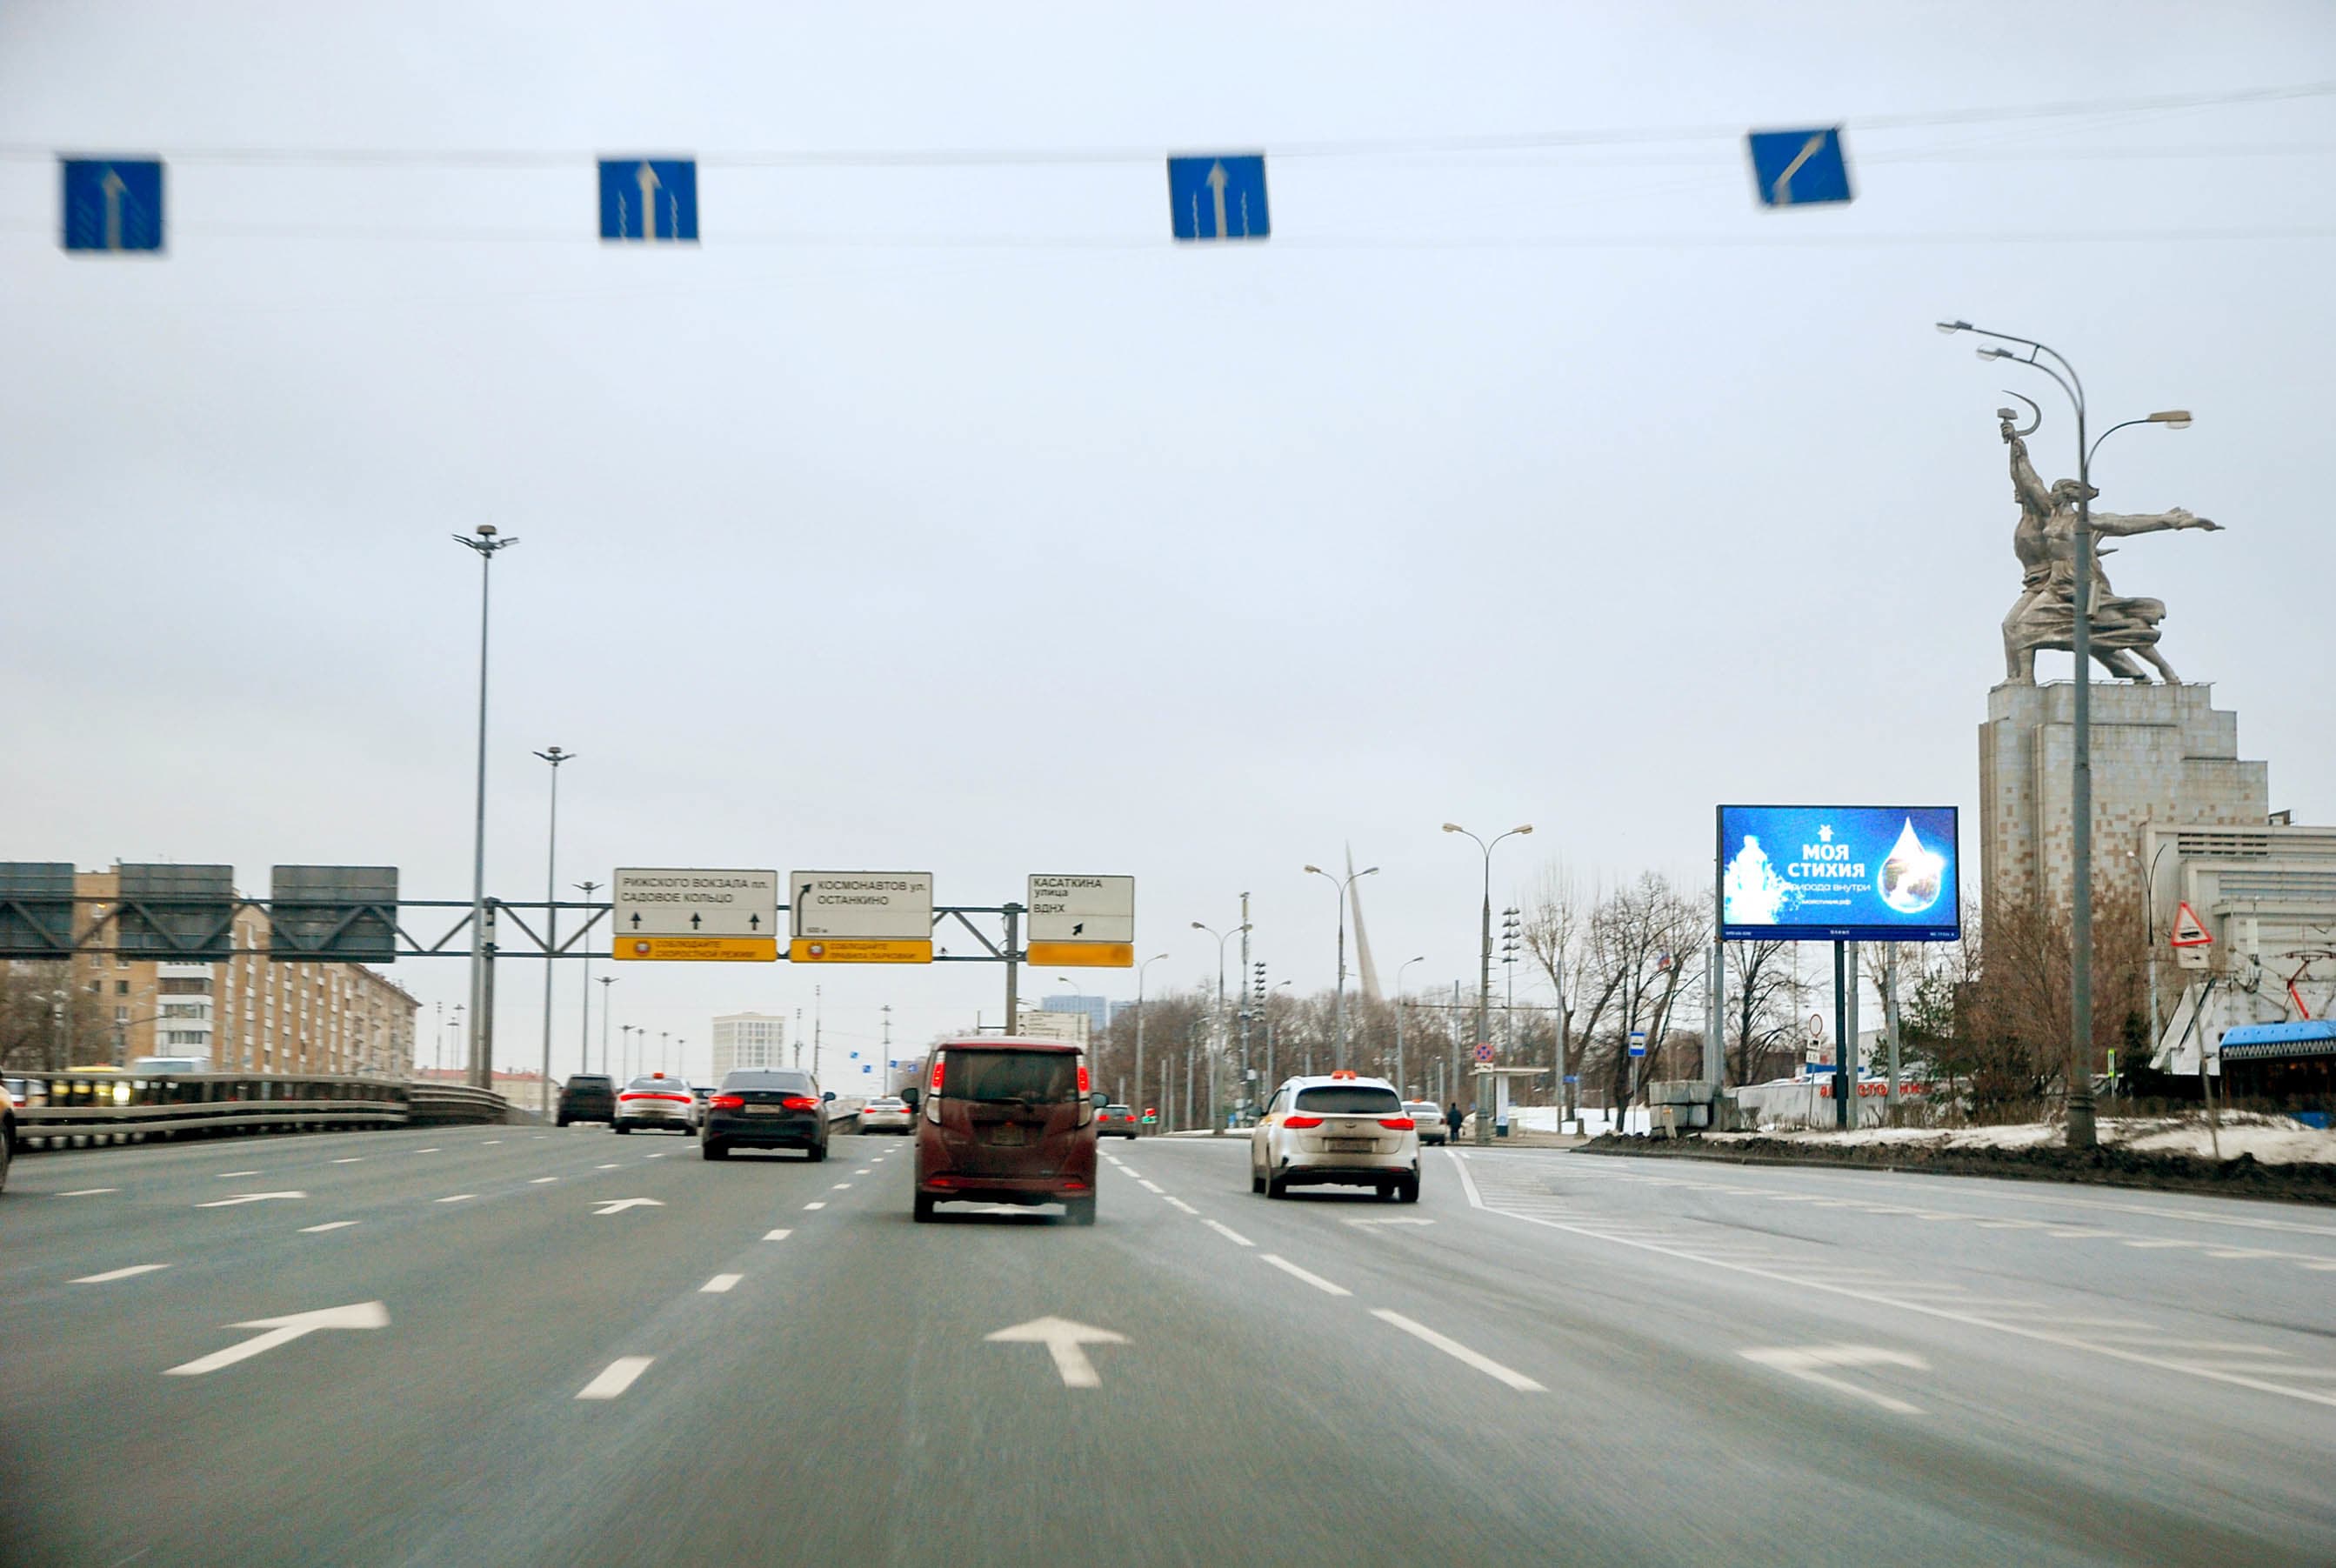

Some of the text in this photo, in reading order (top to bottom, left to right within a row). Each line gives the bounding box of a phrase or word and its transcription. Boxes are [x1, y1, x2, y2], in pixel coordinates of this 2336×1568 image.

[1803, 844, 1849, 861] МОЯ
[1787, 863, 1865, 878] СТИХИЯ
[623, 877, 690, 888] РИЖСКОГО
[692, 878, 748, 889] ВОКЗАЛА
[818, 880, 907, 891] КОСМОНАВТОВ
[1033, 877, 1103, 888] КАСАТКИНА
[1034, 889, 1069, 898] улица
[1832, 883, 1872, 894] внутри
[621, 892, 734, 904] САДОВОЕ КОЛЬЦО
[818, 895, 889, 906] ОСТАНКИНО
[1033, 904, 1065, 914] ВДНХ
